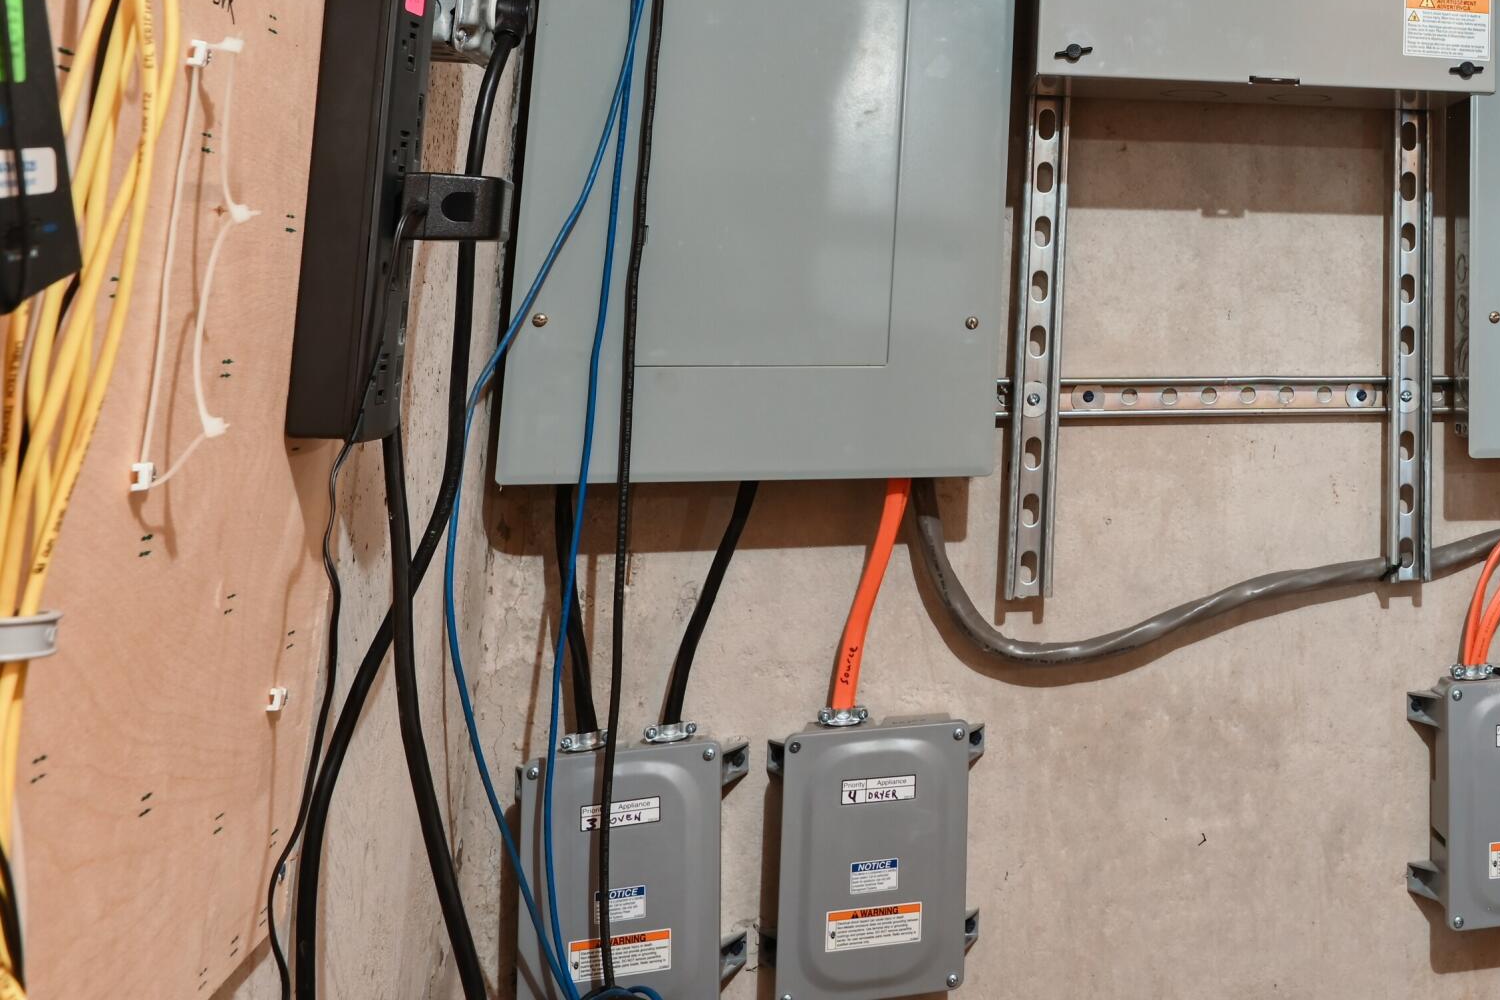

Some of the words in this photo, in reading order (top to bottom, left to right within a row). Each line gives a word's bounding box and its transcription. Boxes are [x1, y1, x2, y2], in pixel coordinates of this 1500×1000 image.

[840, 645, 859, 686] Source
[843, 782, 866, 790] Priority
[877, 778, 907, 787] Appliance
[848, 790, 857, 803] 4
[868, 789, 898, 800] DRYER
[618, 800, 651, 811] Appliance
[586, 818, 598, 831] 3
[857, 860, 892, 872] NOTICE
[609, 887, 639, 899] OTICE
[860, 906, 899, 918] WARNING
